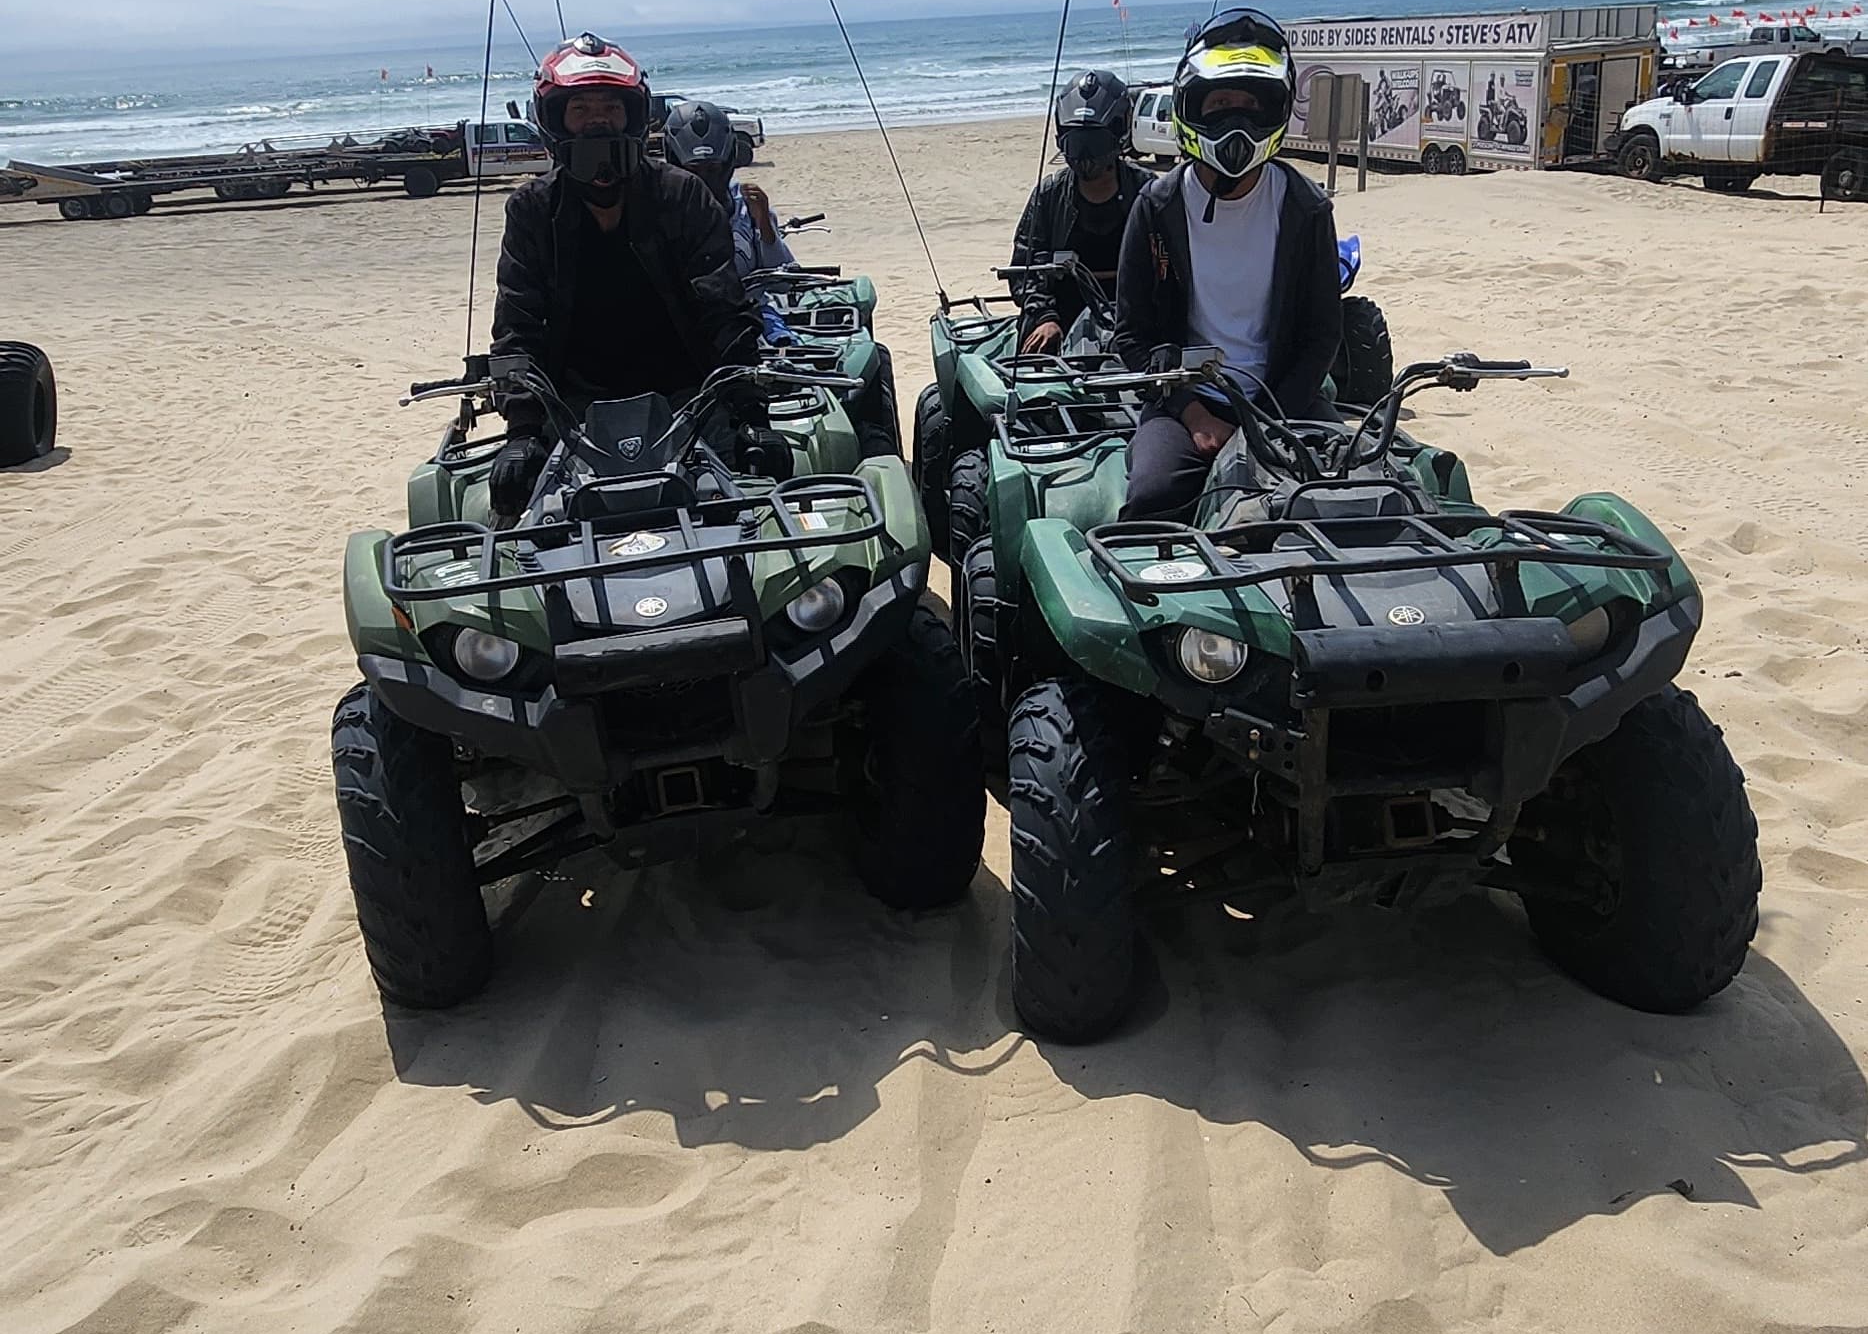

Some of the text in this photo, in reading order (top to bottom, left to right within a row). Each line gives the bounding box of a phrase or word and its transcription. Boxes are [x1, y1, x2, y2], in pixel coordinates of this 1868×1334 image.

[1301, 28, 1325, 47] SIDE
[1327, 28, 1342, 46] BY
[1344, 27, 1377, 46] SIDES
[1380, 25, 1435, 46] RENTALS
[1446, 24, 1501, 45] STEVE'S
[1505, 22, 1538, 44] ATV
